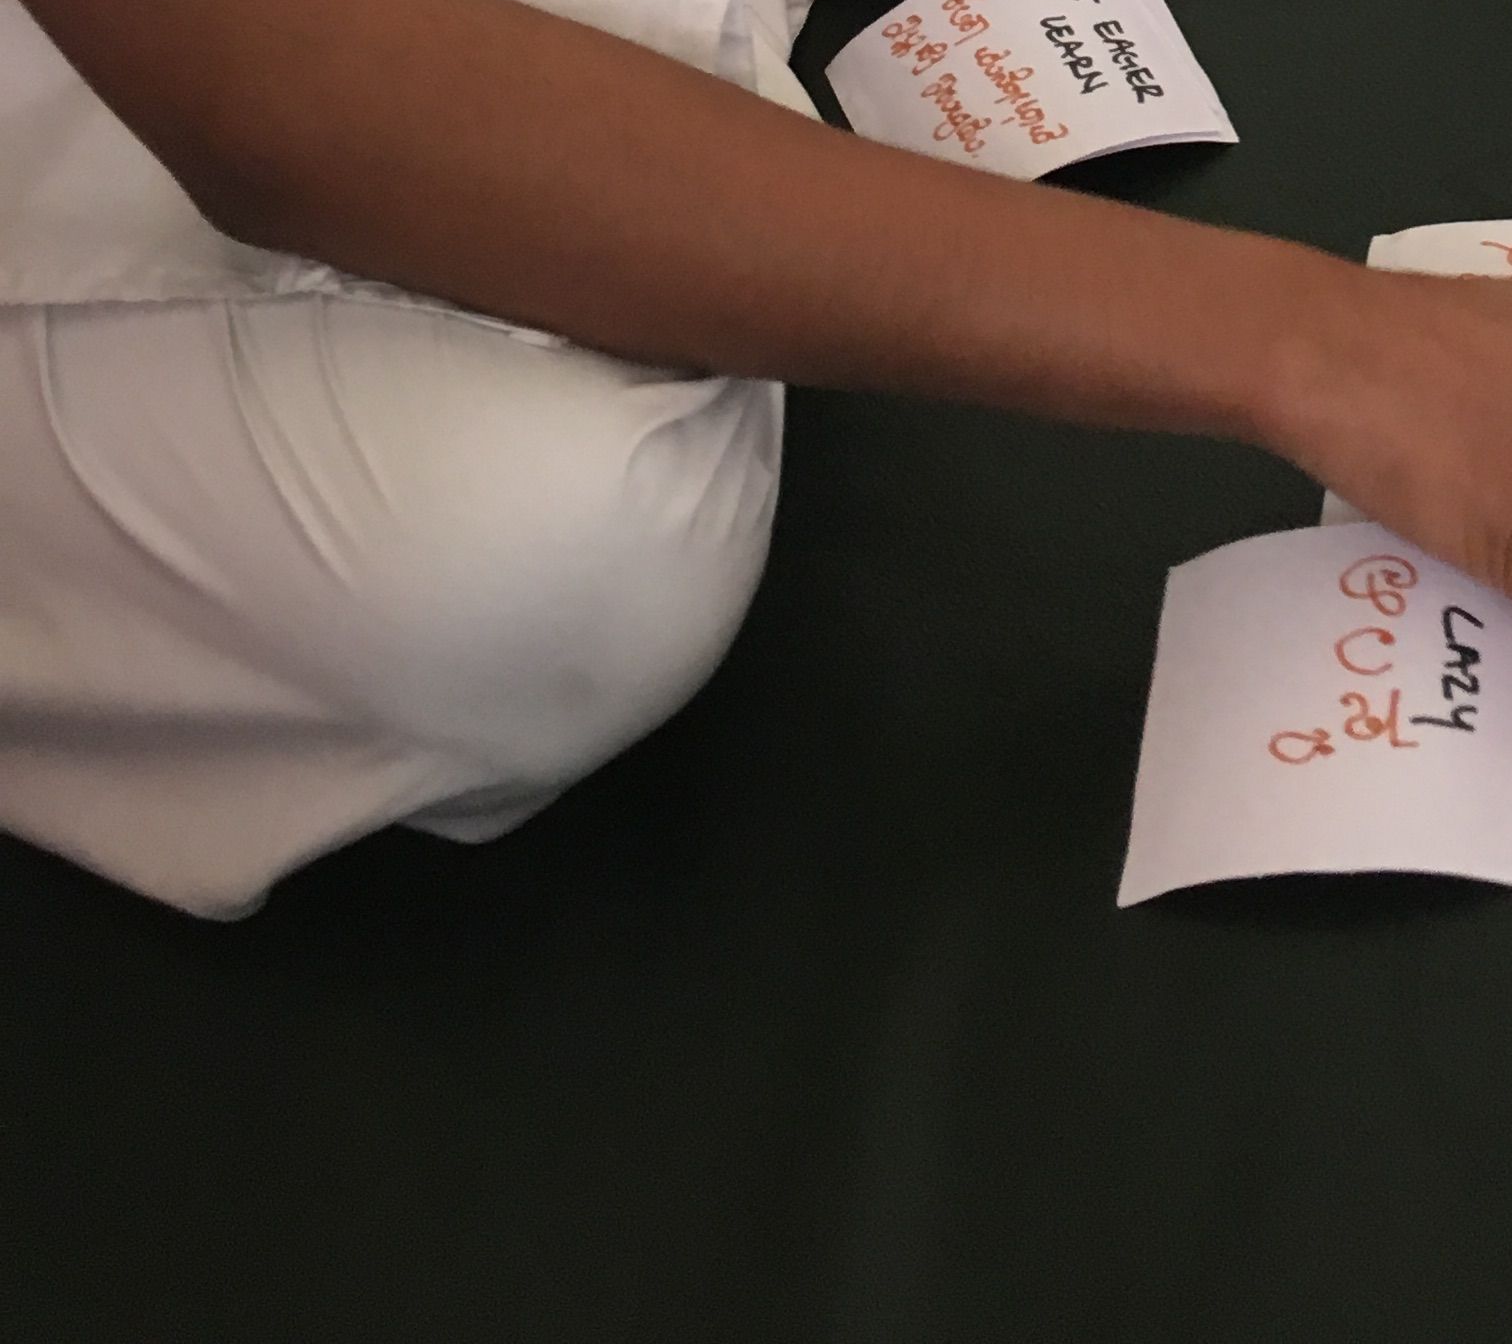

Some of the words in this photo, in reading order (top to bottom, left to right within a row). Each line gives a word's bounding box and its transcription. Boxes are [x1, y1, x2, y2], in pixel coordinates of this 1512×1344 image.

[1040, 15, 1109, 95] LEARN
[1093, 19, 1165, 104] EAGER
[1409, 604, 1485, 734] LAZY
